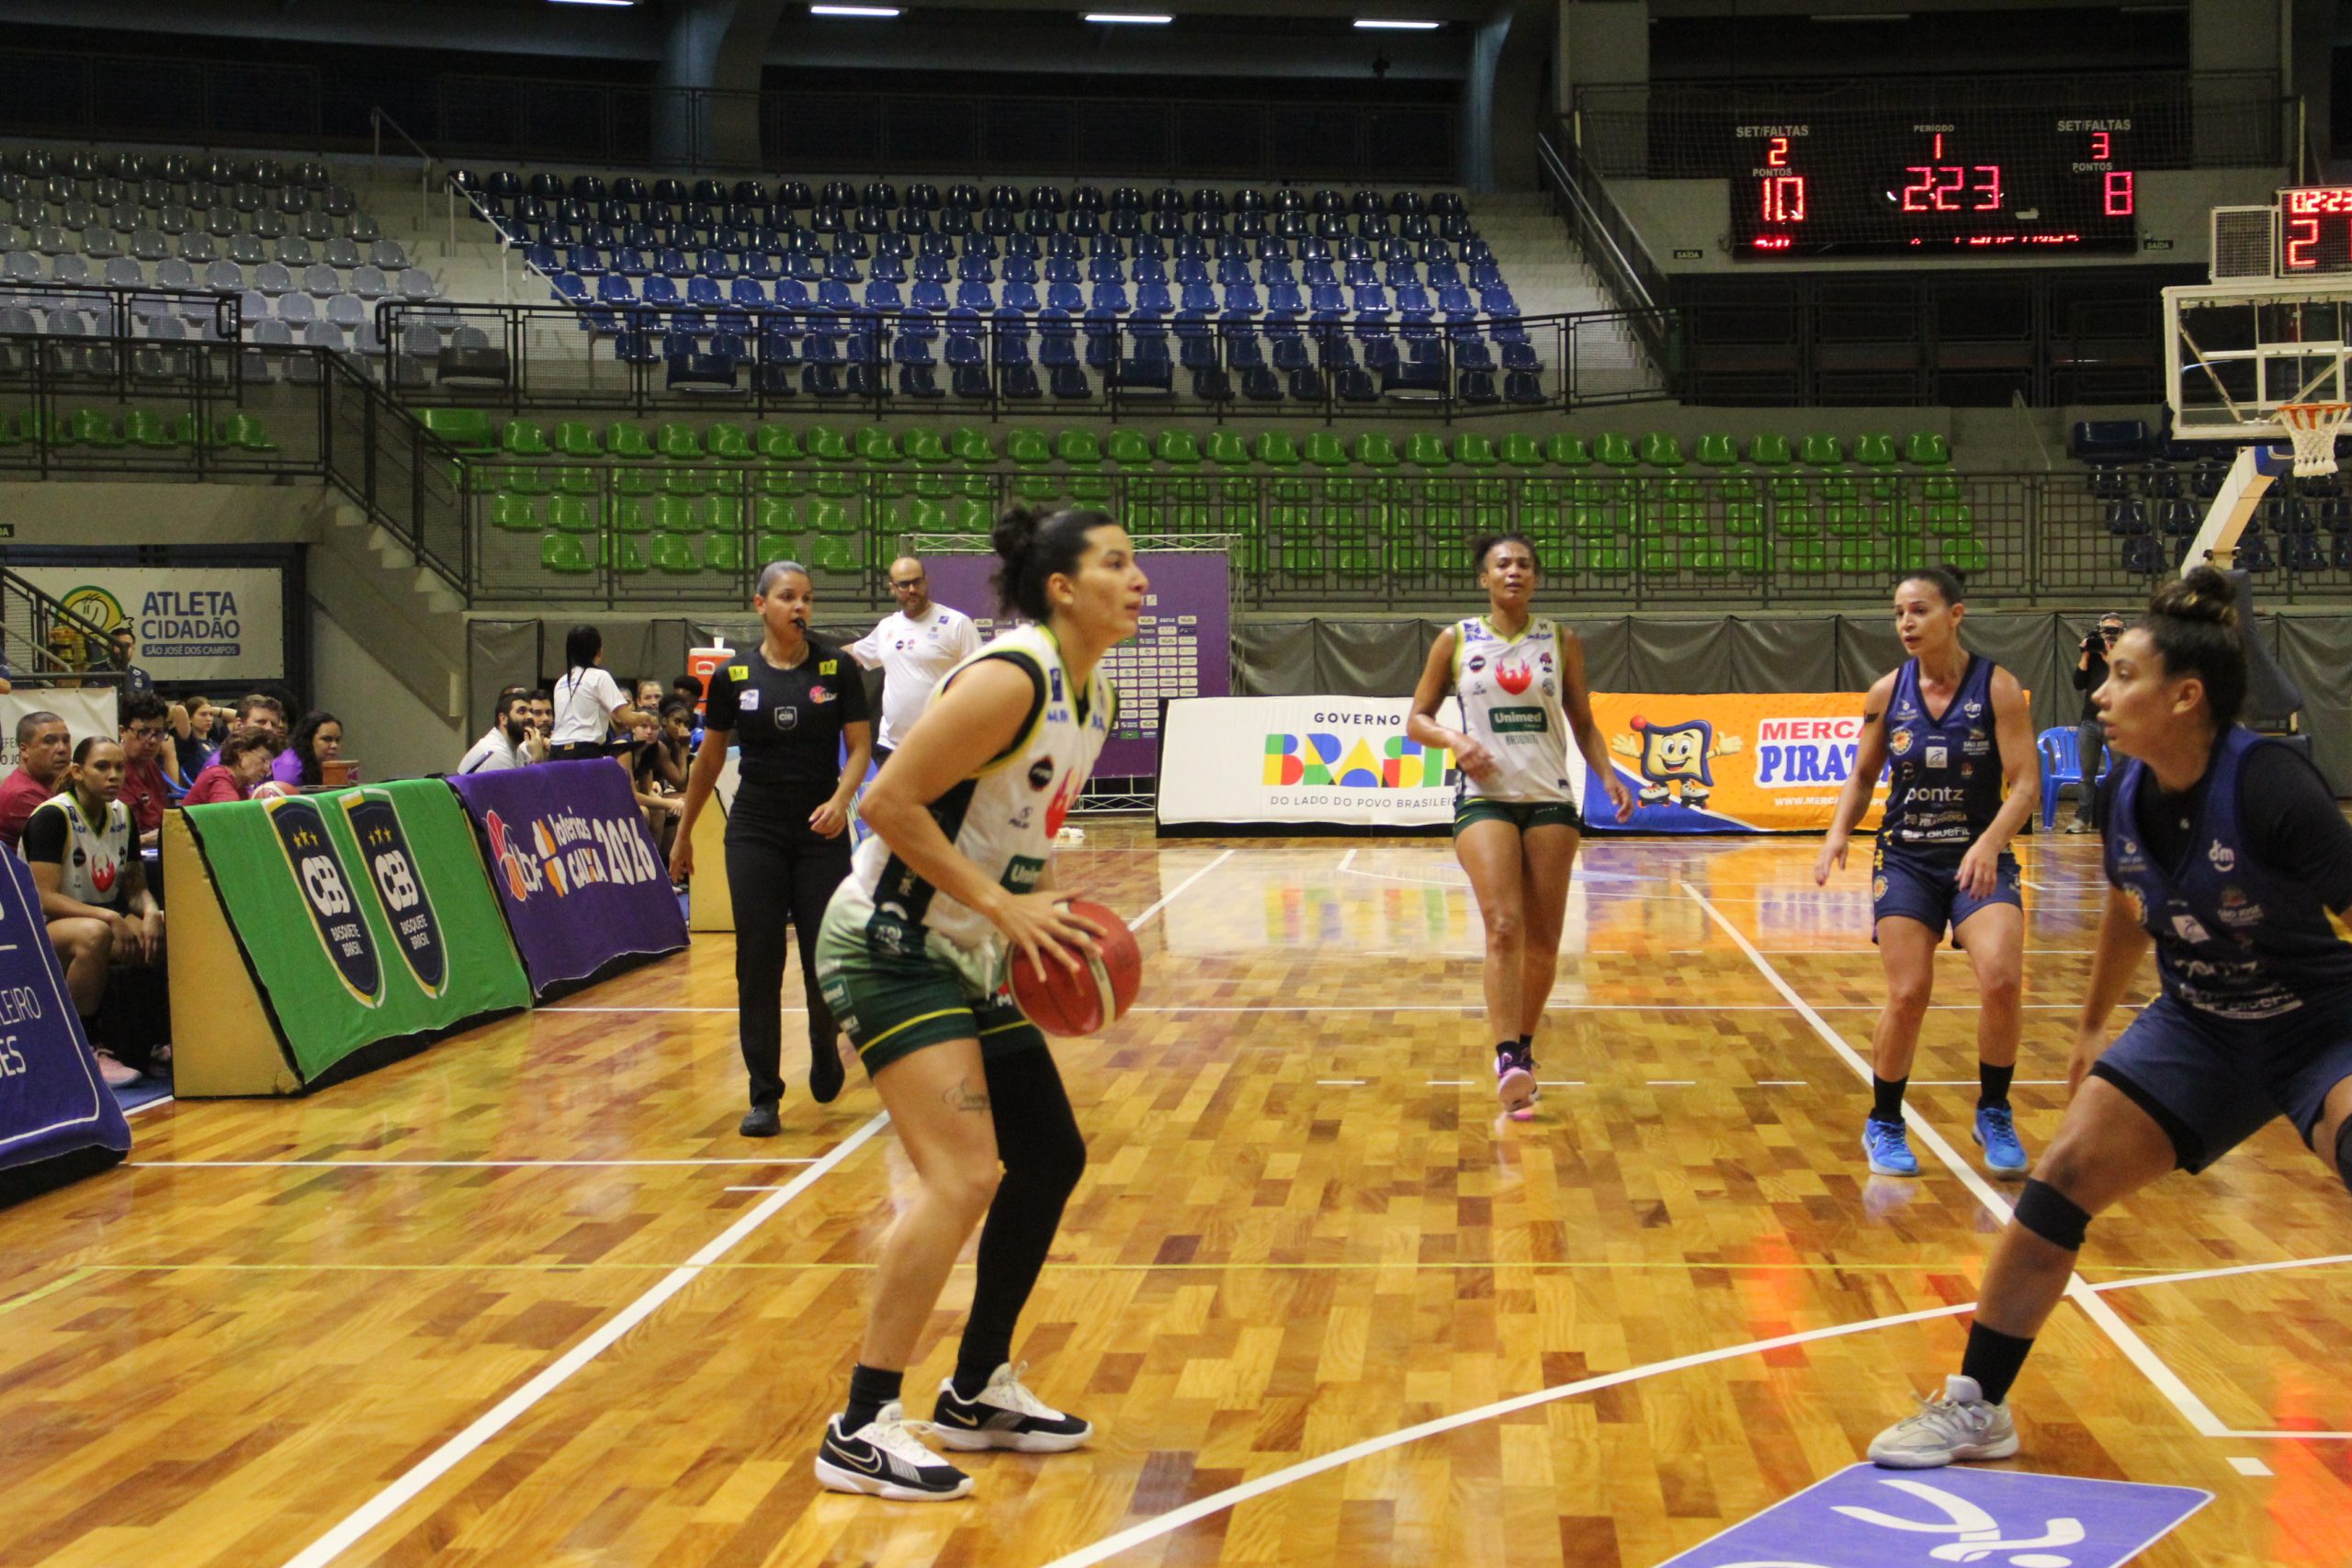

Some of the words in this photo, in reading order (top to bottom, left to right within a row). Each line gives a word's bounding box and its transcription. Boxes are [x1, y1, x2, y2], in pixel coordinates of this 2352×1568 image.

[1736, 125, 1809, 137] SET/FALTAS
[2057, 118, 2132, 131] SET/FALTAS
[1769, 138, 1788, 165] 2
[1935, 133, 1941, 160] 1
[2092, 132, 2110, 160] 3
[1752, 167, 1792, 176] PONTOS
[2073, 163, 2113, 173] PONTOS
[1764, 176, 1804, 220] 10
[2105, 171, 2133, 216] 8
[142, 591, 238, 616] ATLETA
[141, 616, 241, 639] CIDADÃO
[147, 645, 163, 655] SÃO
[164, 645, 184, 655] JOSÉ
[185, 646, 201, 655] DOS
[203, 646, 236, 655] CAMPOS
[1314, 712, 1401, 726] GOVERNO
[1494, 712, 1543, 724] Unimed
[1271, 796, 1289, 806] DO
[1295, 795, 1329, 807] LADO
[1334, 796, 1352, 807] DO
[1358, 798, 1391, 808] POVO
[1904, 786, 1964, 805] pontz
[548, 806, 593, 846] loterias
[593, 818, 656, 886] 2026
[375, 850, 419, 911] CBB
[567, 848, 608, 888] CAIXA
[301, 855, 351, 917] CBB
[0, 1035, 27, 1078] ES
